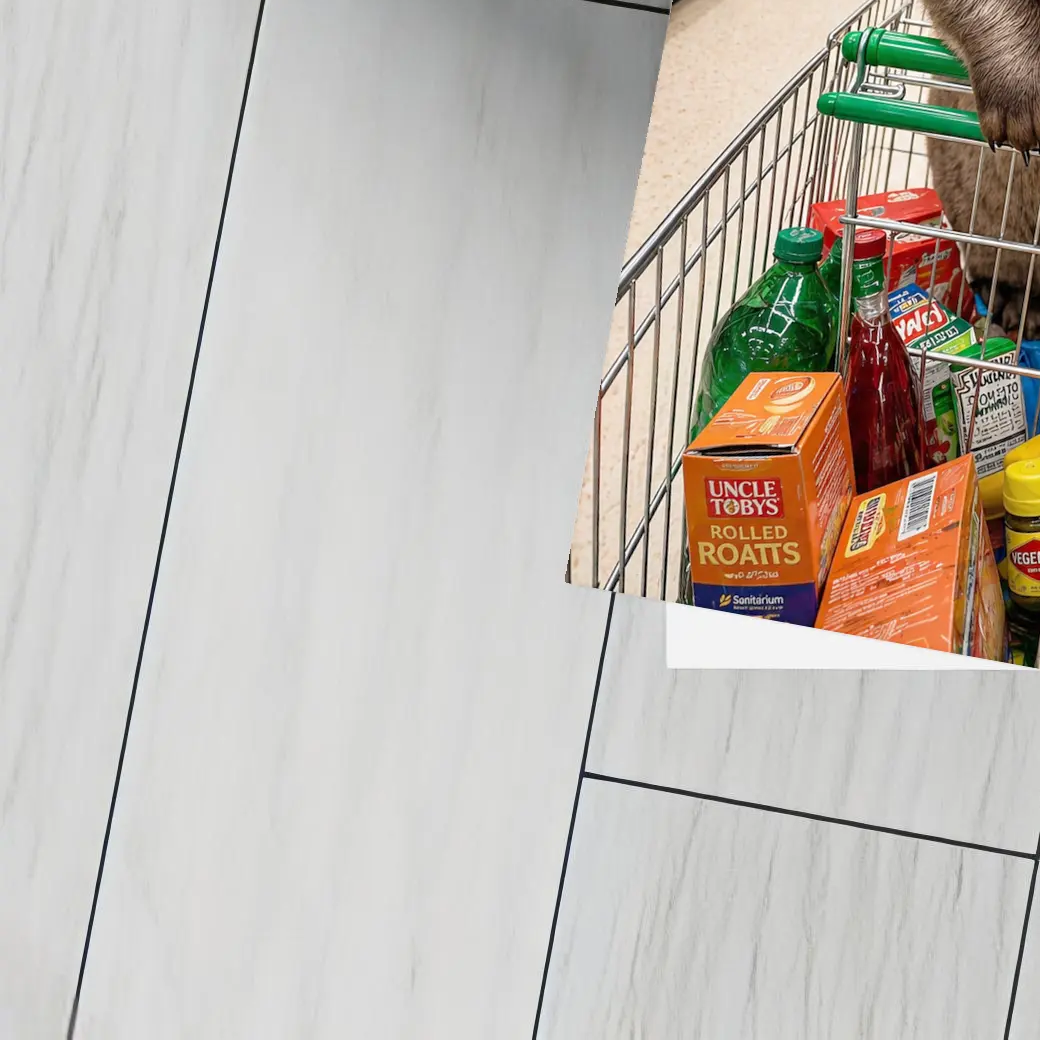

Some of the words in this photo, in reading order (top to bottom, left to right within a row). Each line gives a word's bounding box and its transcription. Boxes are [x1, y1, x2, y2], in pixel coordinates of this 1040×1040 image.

[708, 480, 777, 498] UNCLE
[710, 497, 779, 516] TOBYS
[710, 524, 788, 540] ROLLED
[698, 541, 801, 565] ROATTS
